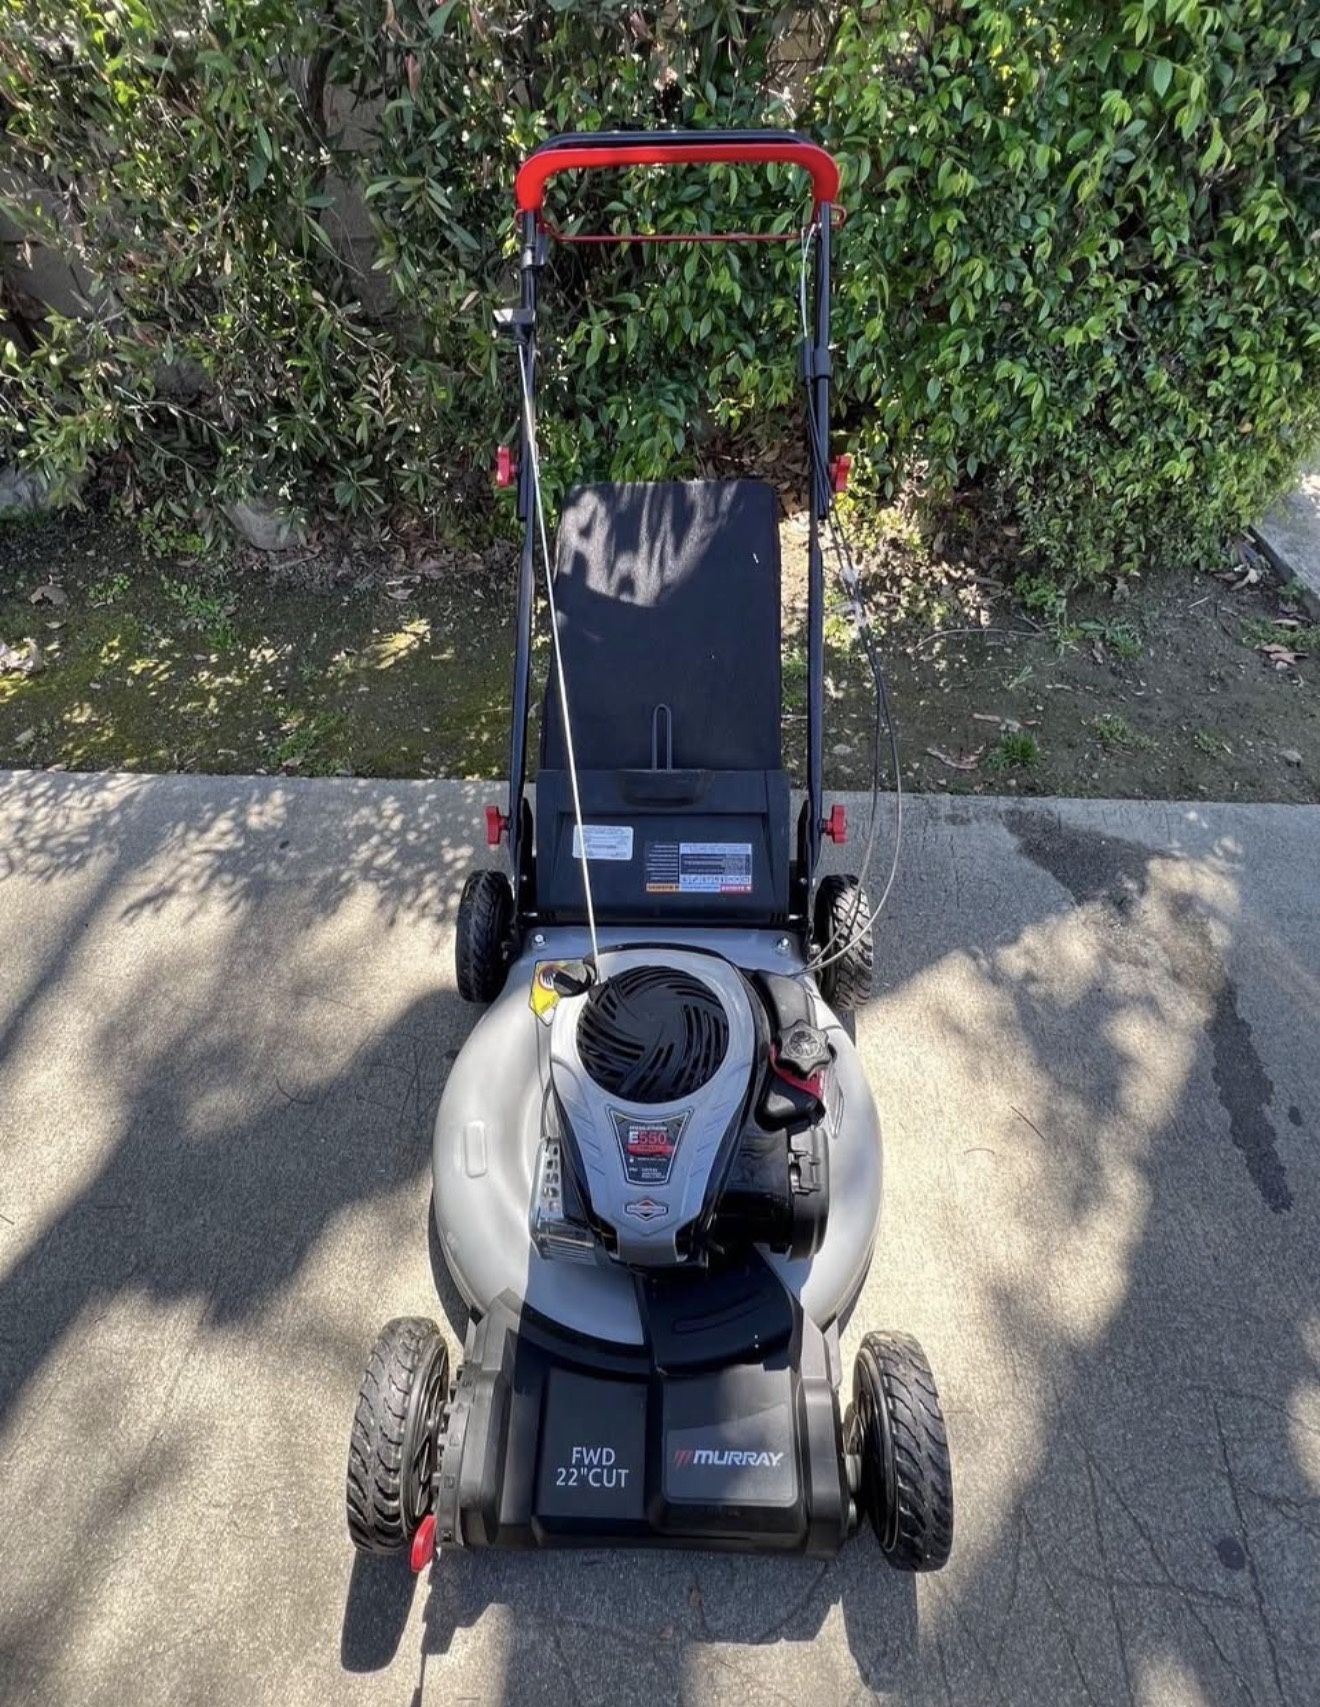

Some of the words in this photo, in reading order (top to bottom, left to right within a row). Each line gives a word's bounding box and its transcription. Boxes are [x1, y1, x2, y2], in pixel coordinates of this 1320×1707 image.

[629, 1131, 667, 1145] E550
[571, 1446, 616, 1466] FWD
[693, 1449, 784, 1467] MURRAY
[556, 1467, 629, 1488] 22"CUT
